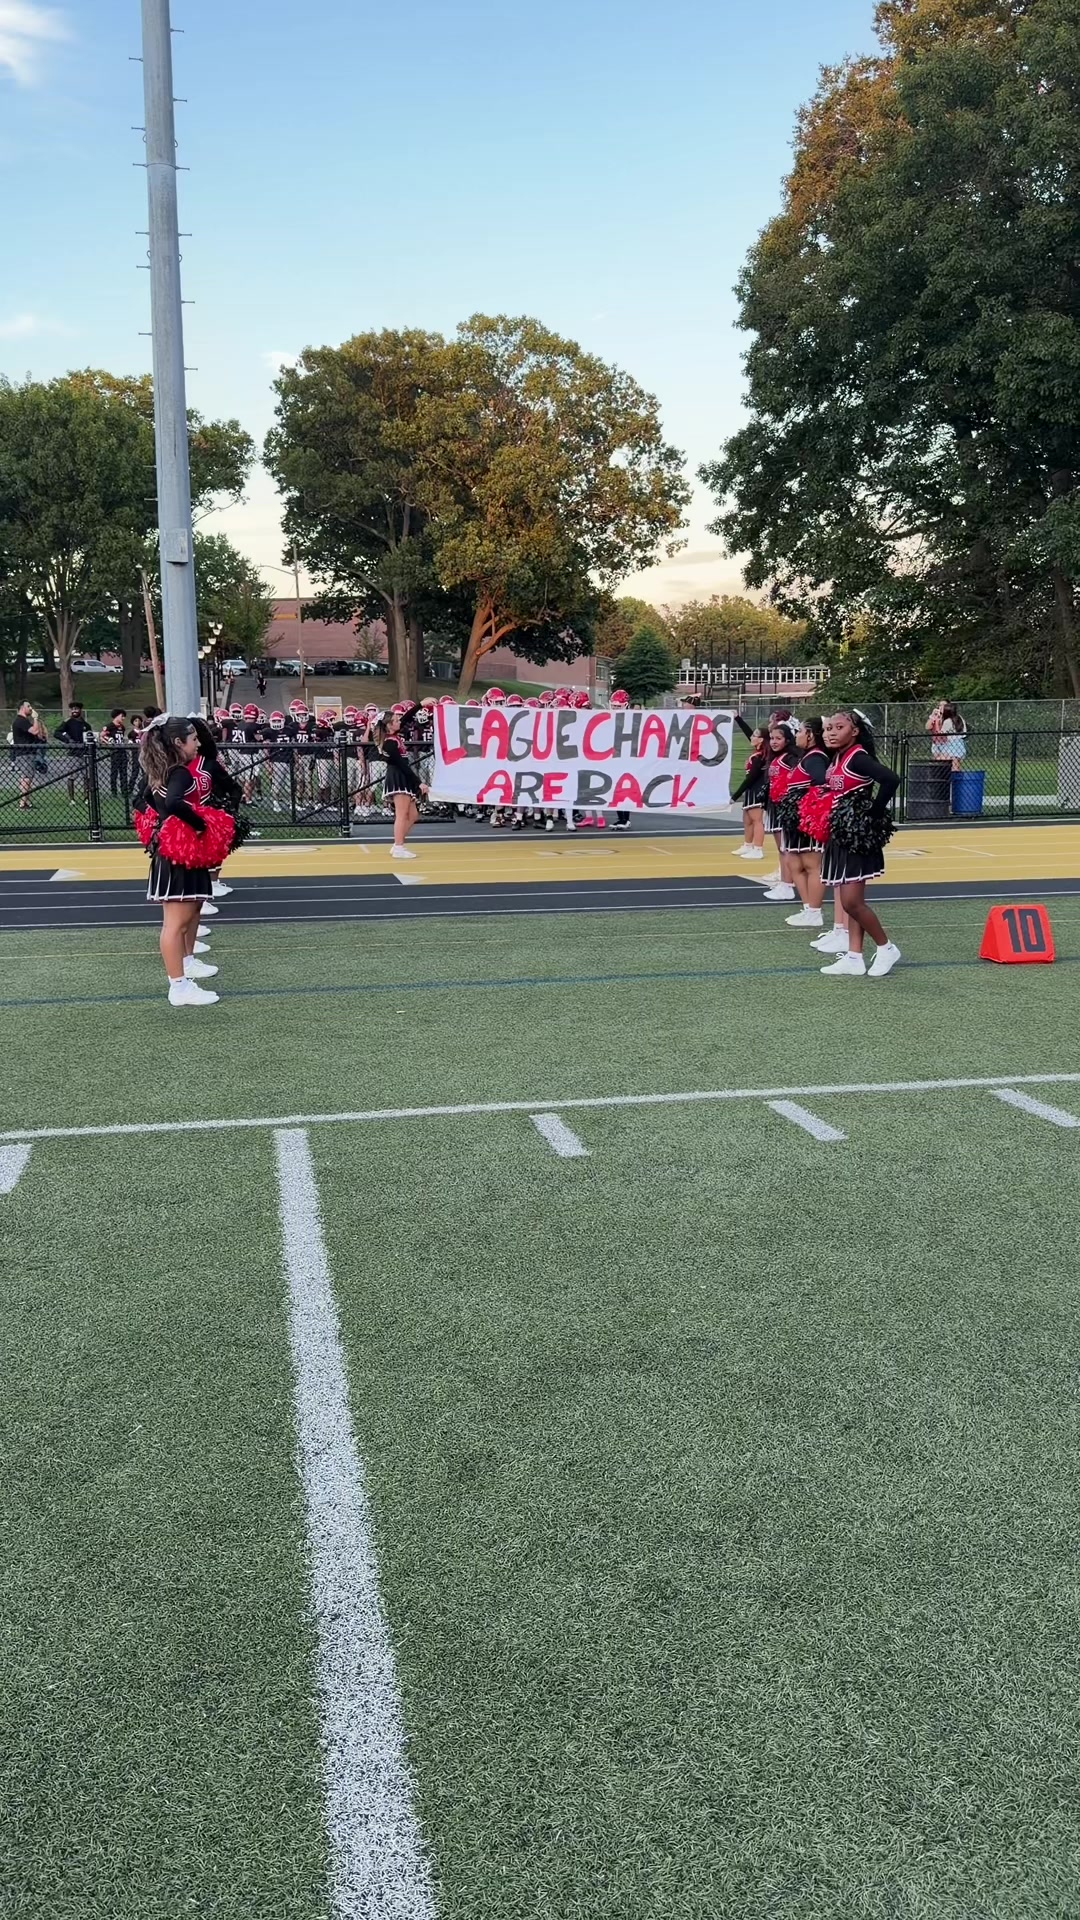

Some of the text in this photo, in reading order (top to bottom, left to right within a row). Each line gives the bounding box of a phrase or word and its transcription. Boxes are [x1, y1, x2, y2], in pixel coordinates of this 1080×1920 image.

[433, 704, 732, 767] LEAGUE CHAMPS
[573, 769, 698, 808] BACK
[1002, 909, 1046, 952] 10
